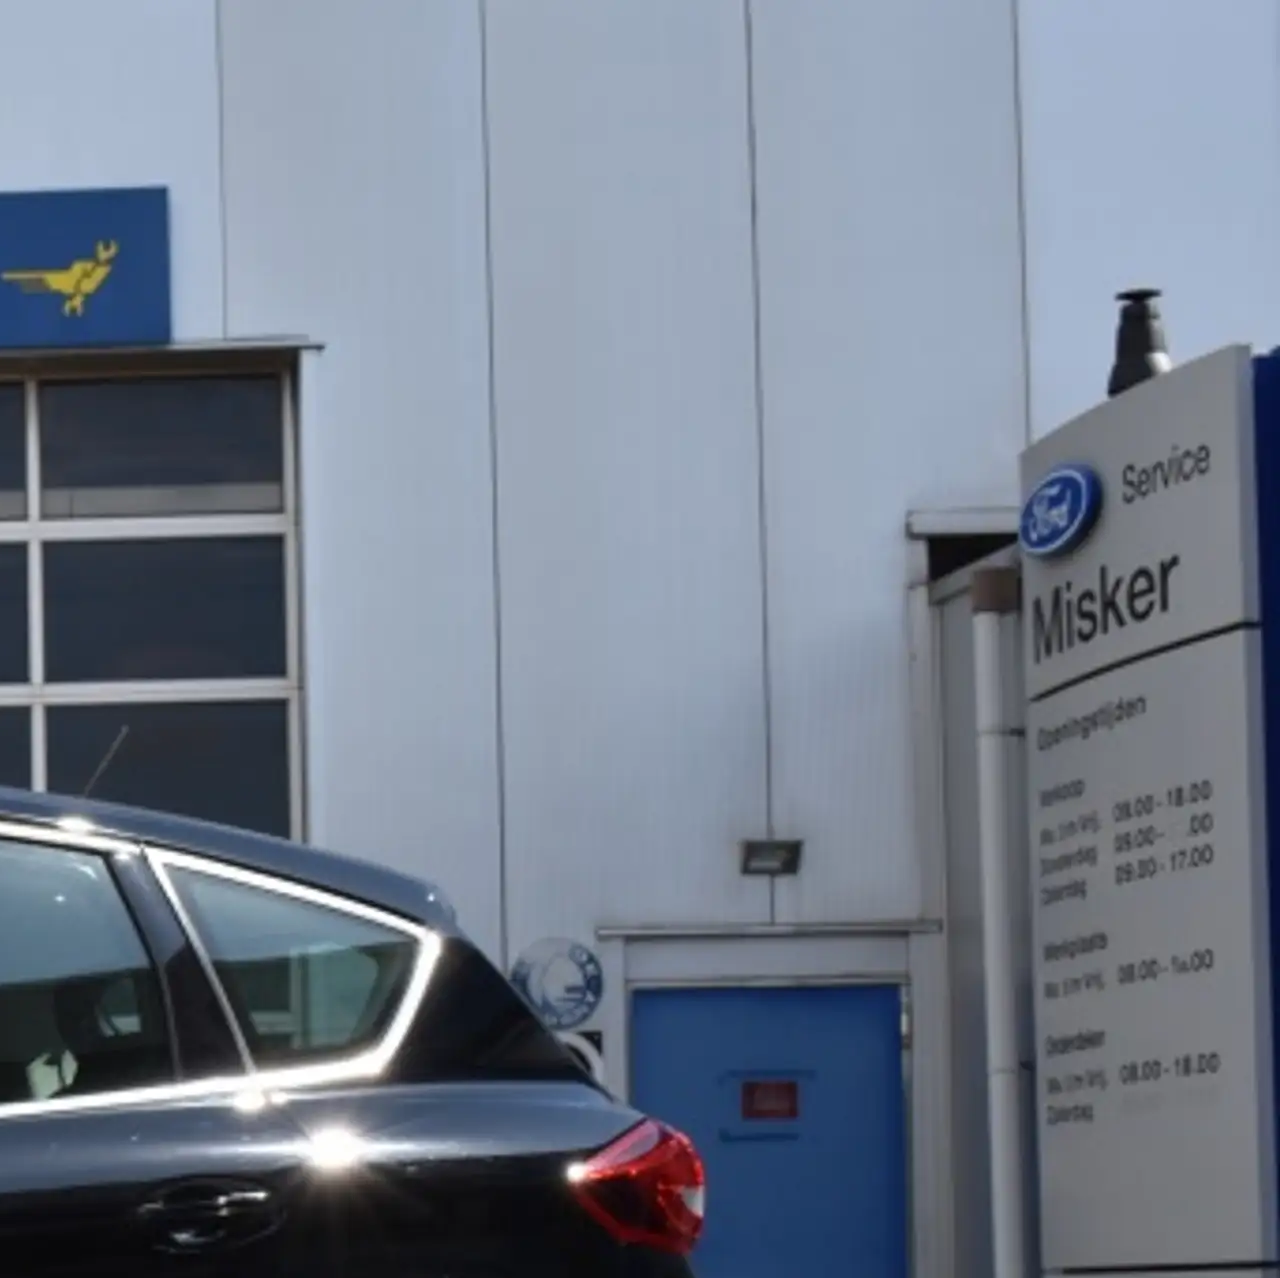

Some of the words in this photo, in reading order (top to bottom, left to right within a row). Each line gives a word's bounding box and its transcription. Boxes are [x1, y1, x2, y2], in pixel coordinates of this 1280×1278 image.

[1122, 443, 1210, 504] Service
[1033, 553, 1180, 665] Misker
[1170, 844, 1214, 873] 17.00
